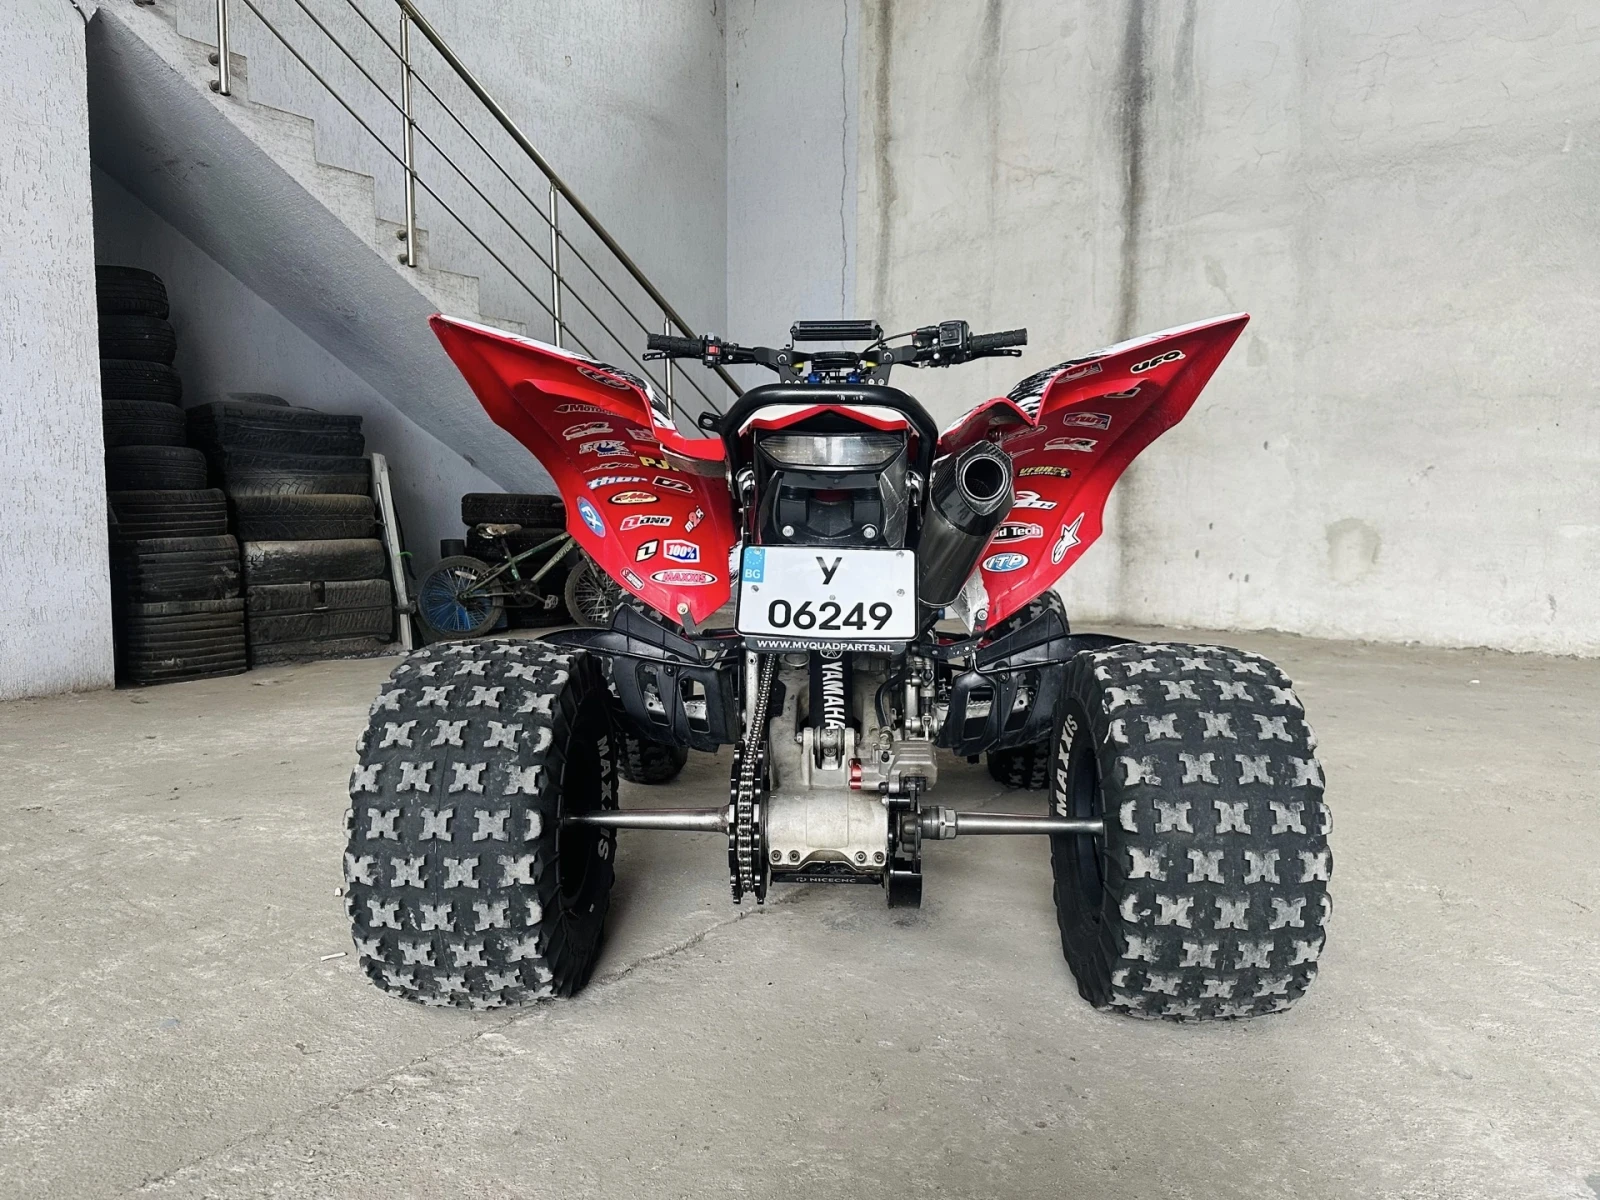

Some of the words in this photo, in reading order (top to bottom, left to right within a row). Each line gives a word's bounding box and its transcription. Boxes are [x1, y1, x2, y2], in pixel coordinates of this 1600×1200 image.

[1131, 350, 1181, 372] UFO
[1010, 525, 1042, 537] Tech
[668, 543, 696, 560] 100%
[987, 555, 1023, 570] ITP
[661, 571, 707, 584] MAXXIS
[744, 568, 761, 580] BG
[767, 599, 893, 631] 06249
[821, 661, 846, 730] YAMAHA
[1055, 713, 1079, 818] MAXXIS
[596, 734, 613, 861] MAXIS
